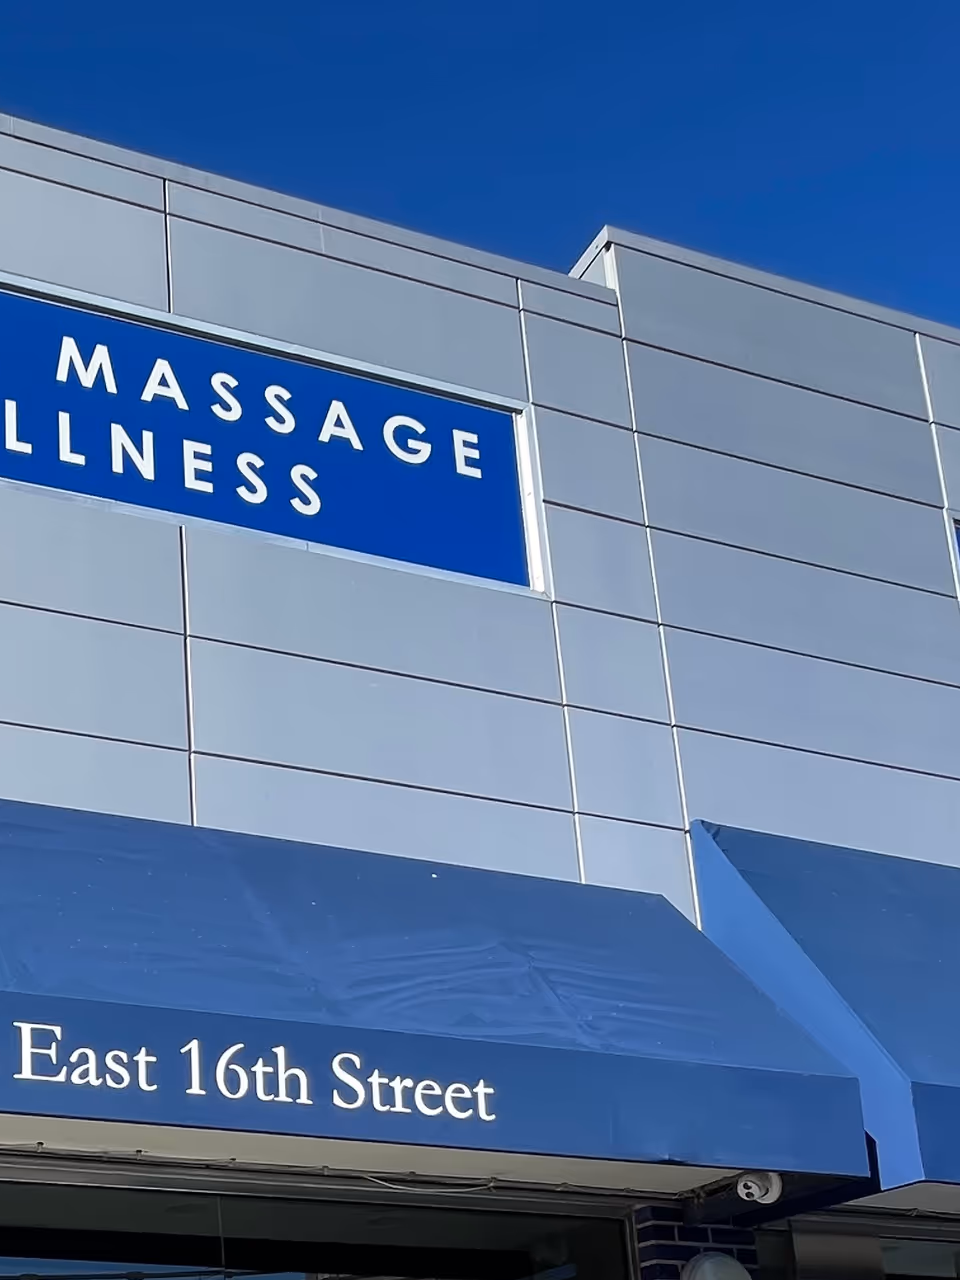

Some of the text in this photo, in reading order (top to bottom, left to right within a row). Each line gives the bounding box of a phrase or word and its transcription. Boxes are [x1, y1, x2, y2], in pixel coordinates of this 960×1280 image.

[56, 336, 483, 480] MASSAGE
[13, 1022, 158, 1093] East
[179, 1039, 314, 1106] 16th
[331, 1053, 497, 1122] Street
